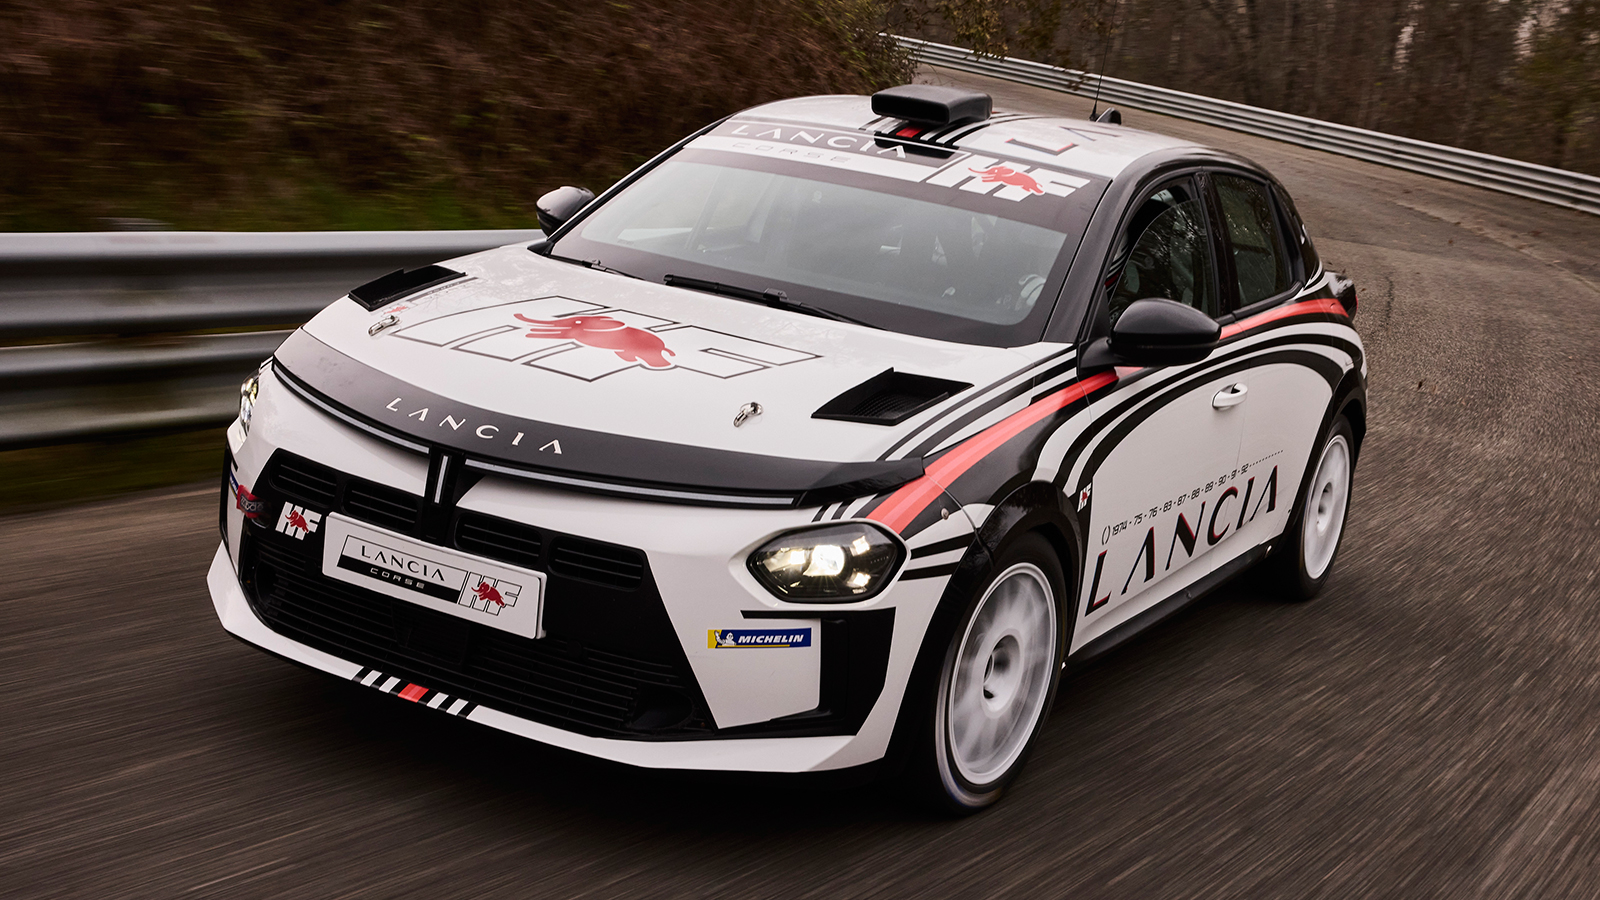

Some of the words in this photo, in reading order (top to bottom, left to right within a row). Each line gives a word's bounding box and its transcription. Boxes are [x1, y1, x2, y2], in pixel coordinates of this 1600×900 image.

[731, 124, 907, 159] LANCIA
[732, 142, 852, 163] CORSE
[926, 154, 1091, 202] HF
[385, 397, 563, 455] LANCIA
[275, 501, 322, 540] HF
[1084, 465, 1278, 617] LANCIA
[361, 545, 445, 582] LANCIA
[370, 567, 425, 589] CORSE
[458, 571, 522, 616] HF
[737, 634, 804, 644] MICHELIN
